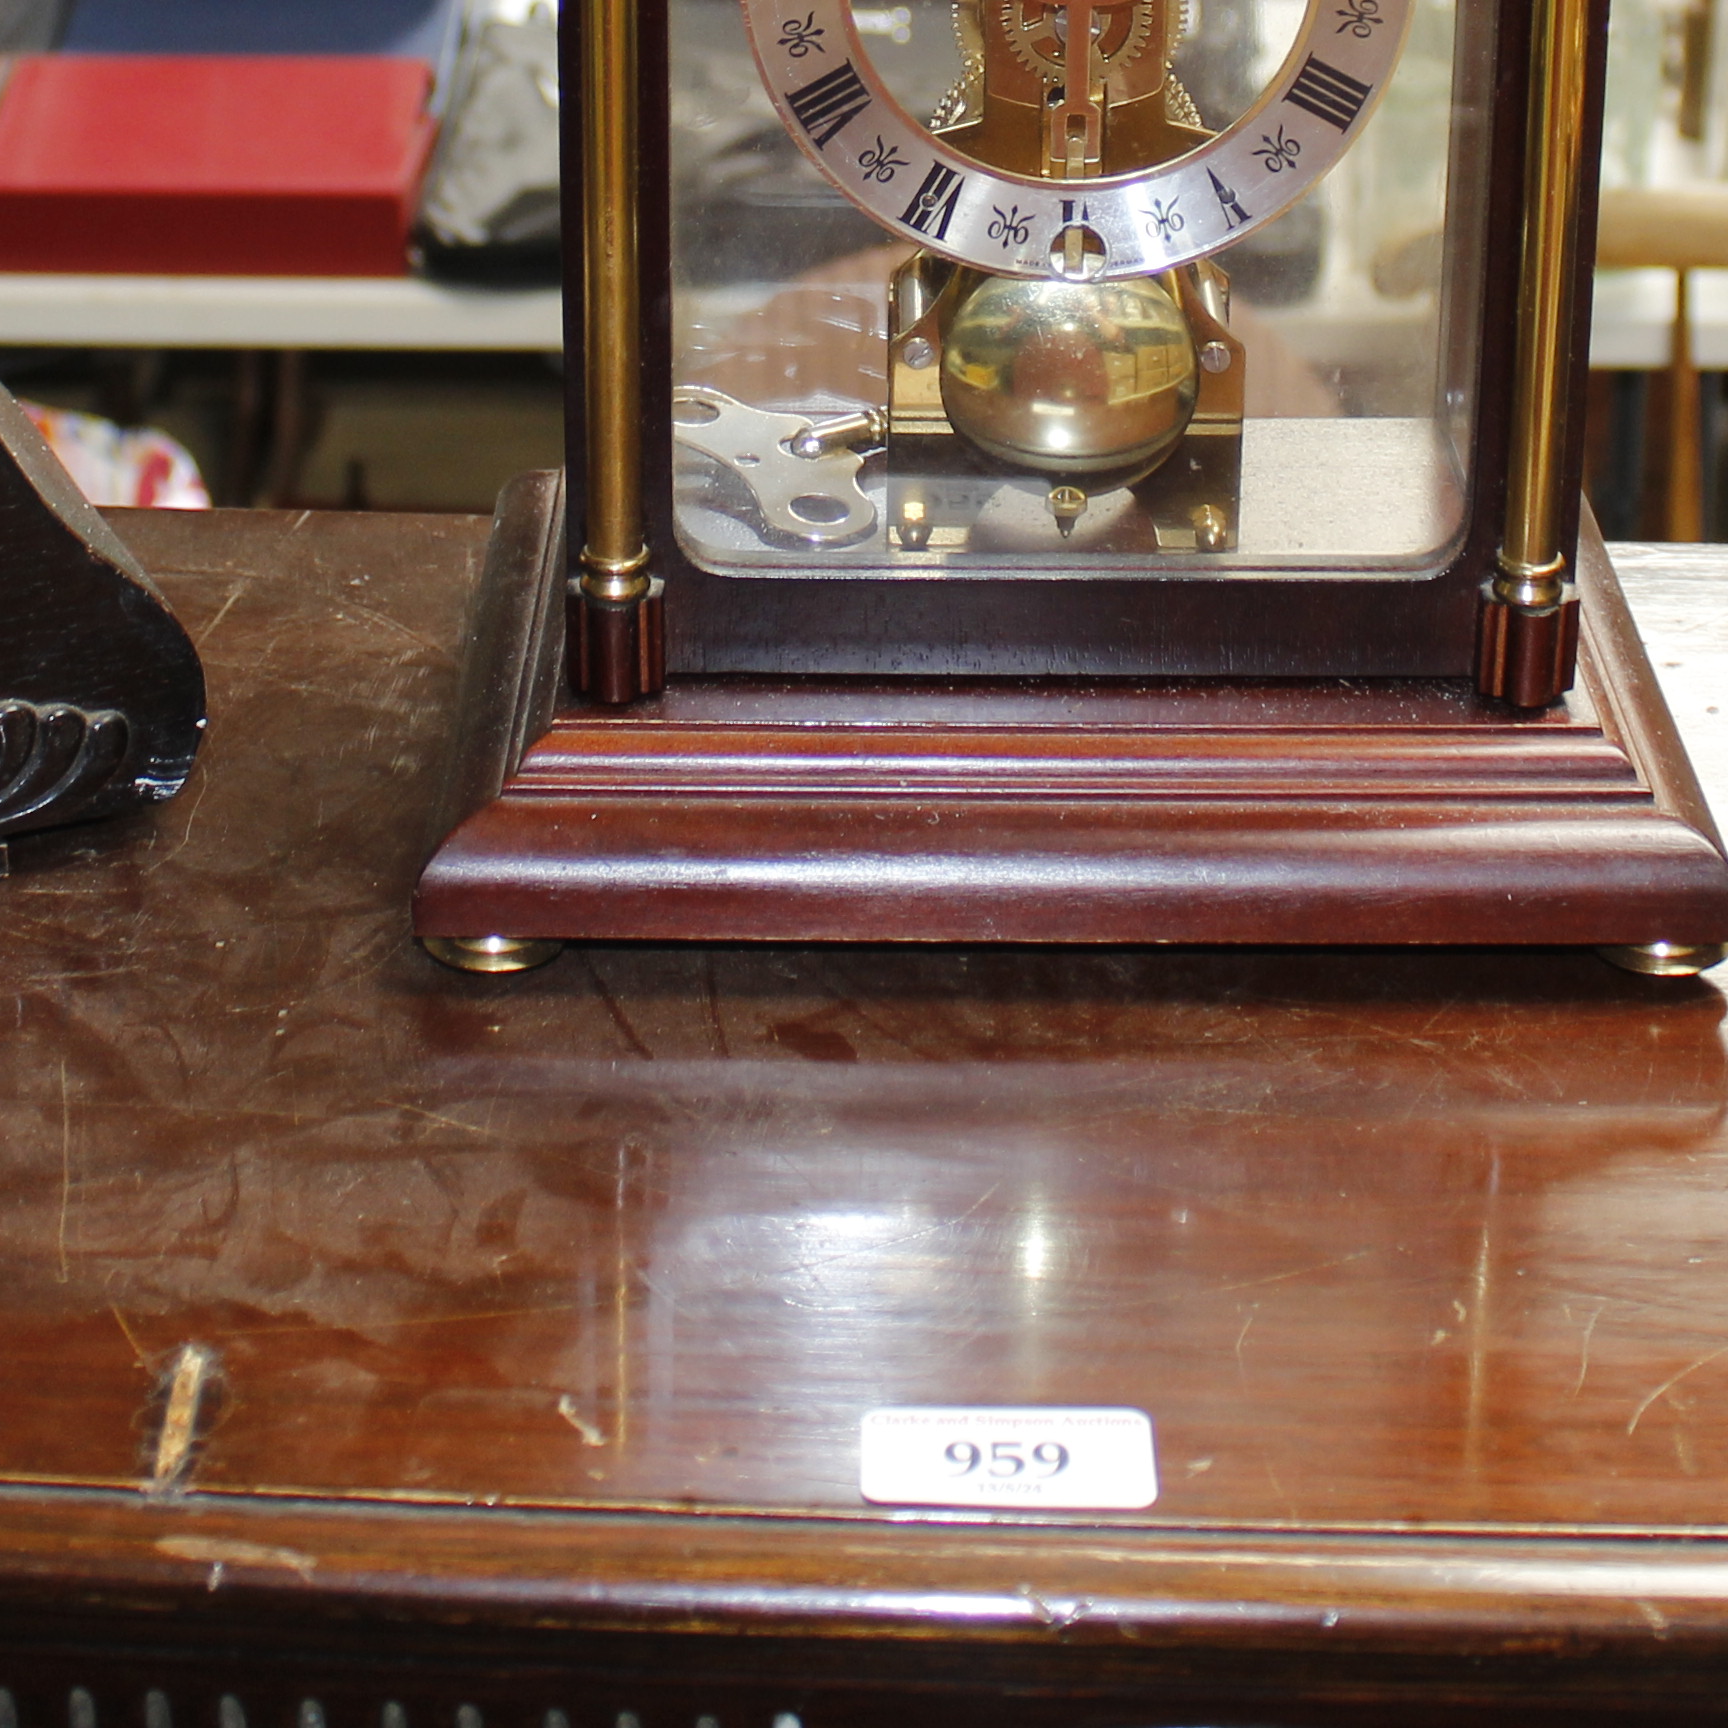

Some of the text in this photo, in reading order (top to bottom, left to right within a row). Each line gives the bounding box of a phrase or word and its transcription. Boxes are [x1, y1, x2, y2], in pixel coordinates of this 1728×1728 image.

[784, 57, 872, 153] VIII
[1281, 51, 1373, 135] IIII
[870, 1415, 1142, 1428] Clarke and Simpson Auctions
[944, 1441, 1070, 1478] 959
